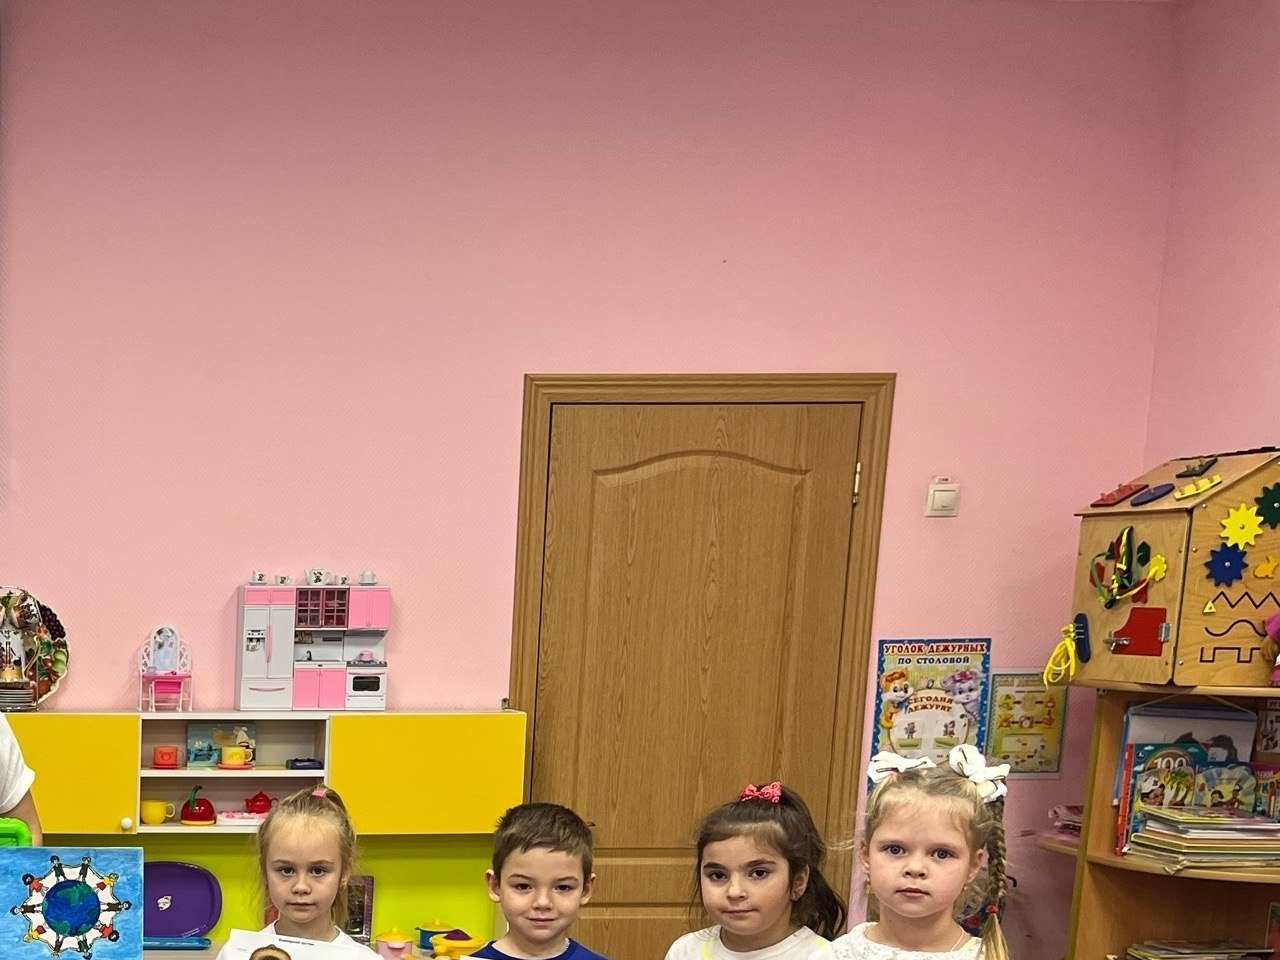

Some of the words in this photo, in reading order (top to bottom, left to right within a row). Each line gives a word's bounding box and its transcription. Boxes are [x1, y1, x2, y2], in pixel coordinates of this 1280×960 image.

[884, 644, 924, 654] УГОЛОК
[928, 643, 986, 654] ДЕЖУРНЫХ
[917, 655, 970, 664] СТОЛОВОЙ
[907, 696, 953, 705] СЕГОДНЯ
[907, 703, 953, 713] ДЕЖУРЯТ
